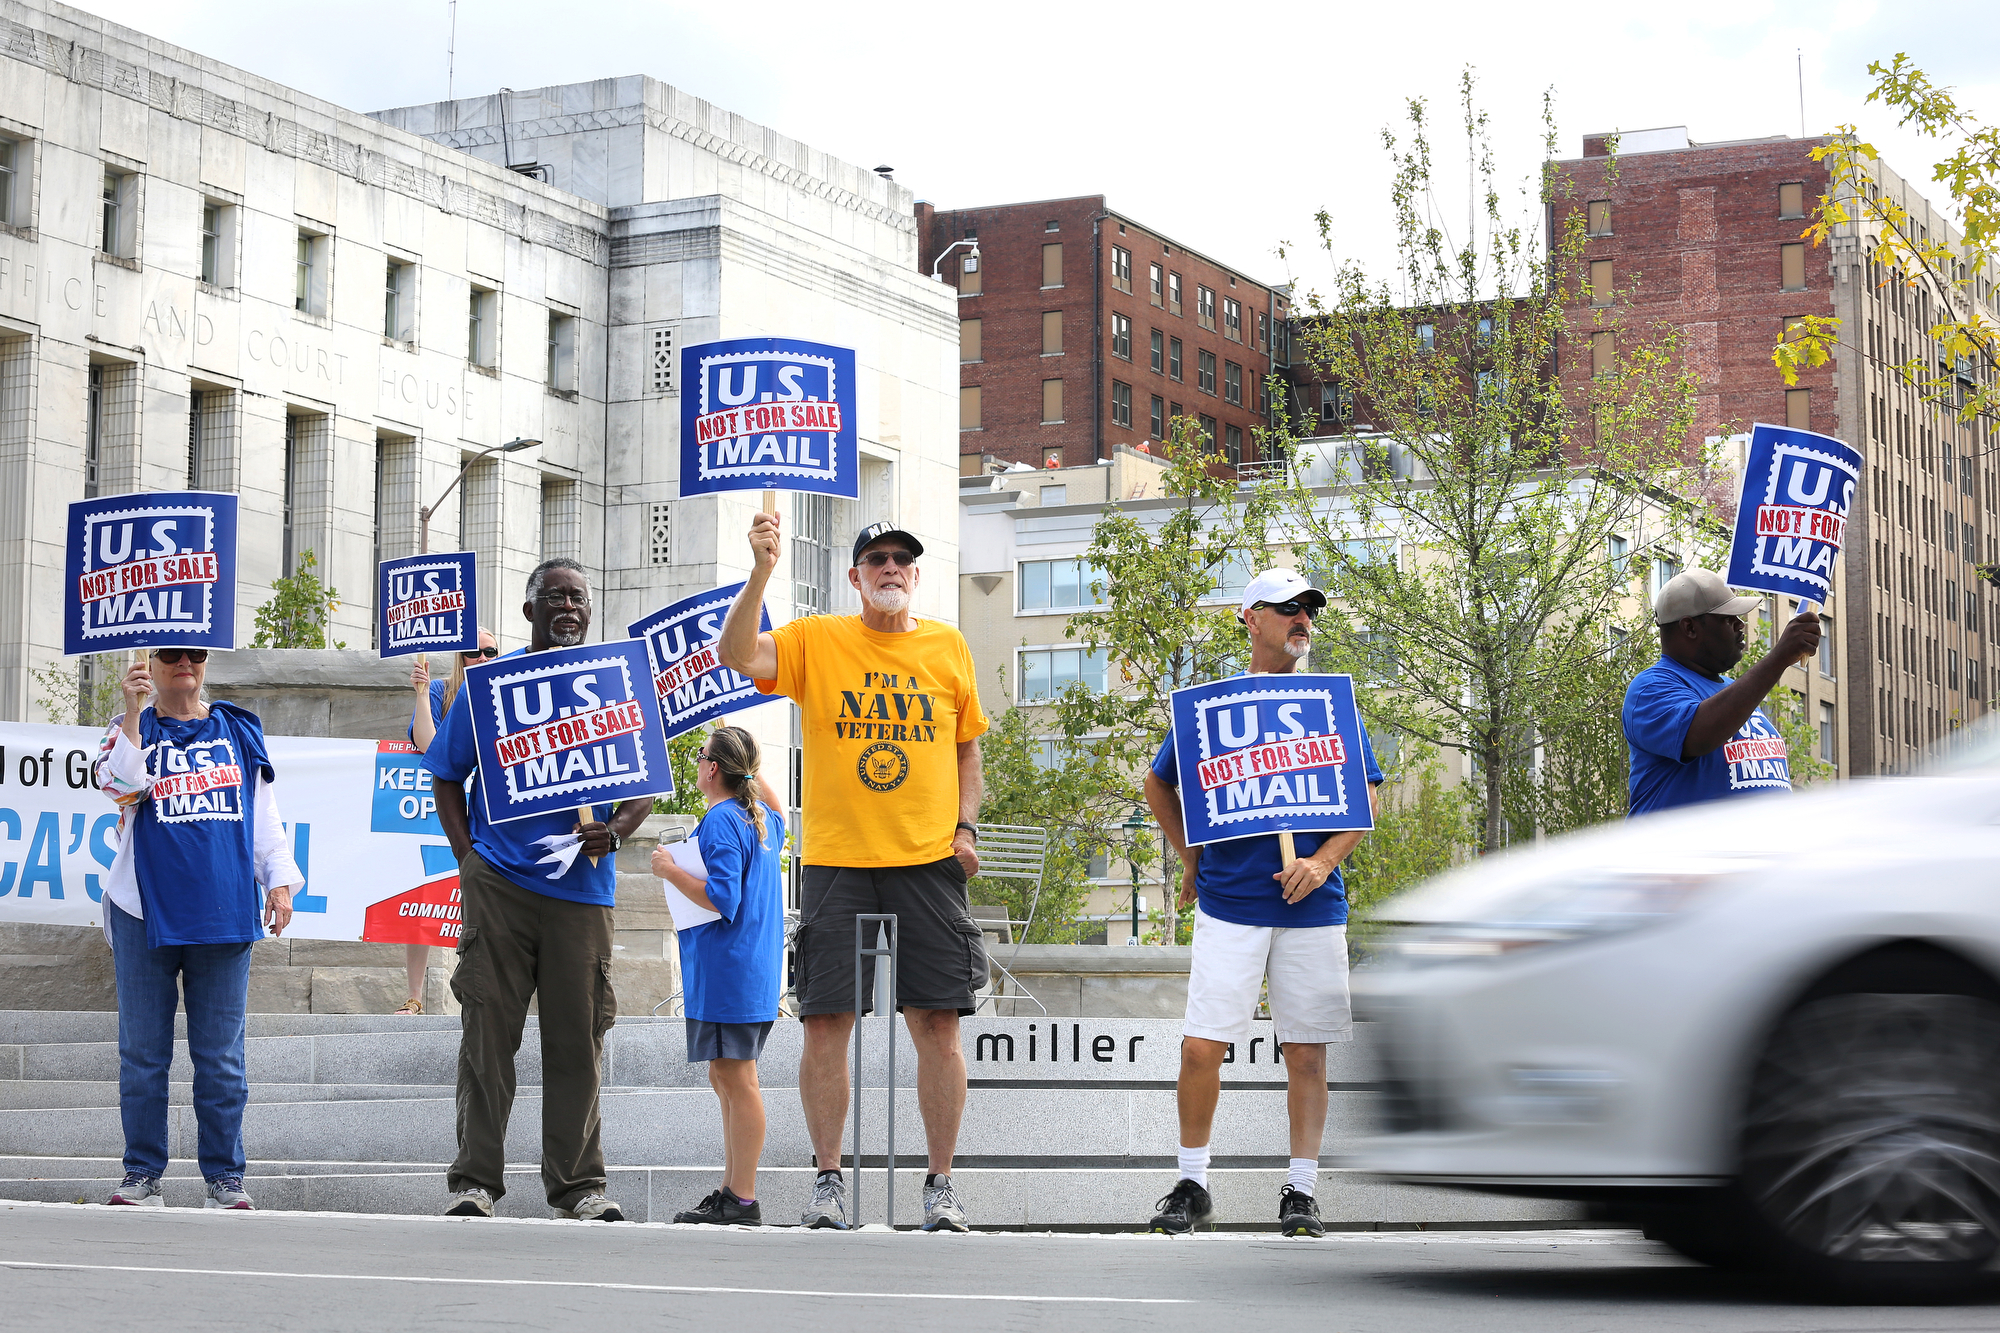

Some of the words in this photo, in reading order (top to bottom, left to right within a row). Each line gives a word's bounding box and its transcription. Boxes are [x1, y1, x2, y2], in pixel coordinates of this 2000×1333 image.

[143, 300, 214, 346] AND
[248, 329, 349, 385] COURT
[382, 366, 474, 421] HOUSE
[717, 365, 819, 406] U.S.
[698, 412, 739, 441] NOT
[743, 406, 786, 431] FOR
[791, 405, 838, 428] SALE
[716, 434, 821, 467] MAIL
[1760, 508, 1806, 534] NOT
[99, 519, 194, 565] U.S.
[82, 570, 117, 600] NOT
[122, 562, 158, 590] FOR
[163, 556, 215, 582] SALE
[396, 571, 450, 601] U.S.
[97, 590, 193, 625] MAIL
[388, 604, 406, 624] NOT
[408, 598, 430, 617] FOR
[431, 593, 463, 611] SALE
[396, 615, 452, 640] MAIL
[655, 665, 683, 696] NOT
[683, 649, 716, 678] FOR
[864, 671, 898, 689] I'M
[905, 676, 920, 690] A
[512, 674, 617, 725] U.S.
[839, 690, 936, 721] NAVY
[498, 729, 541, 764] NOT
[545, 717, 590, 750] FOR
[590, 703, 641, 737] SALE
[835, 721, 937, 742] VETERAN
[1217, 702, 1320, 749] U.S.
[388, 742, 405, 751] THE
[859, 743, 886, 777] UNITED
[886, 744, 907, 778] STATES
[1201, 754, 1245, 786] NOT
[1249, 745, 1292, 772] FOR
[1294, 738, 1343, 765] SALE
[1726, 742, 1751, 761] NOT
[1751, 741, 1771, 757] FOR
[19, 748, 54, 787] of
[154, 777, 183, 798] NOT
[209, 767, 242, 785] SALE
[523, 743, 630, 788] MAIL
[1741, 760, 1789, 780] MAIL
[867, 780, 897, 790] NAVY
[1226, 773, 1330, 811] MAIL
[168, 791, 233, 816] MAIL
[976, 1023, 1145, 1063] miller
